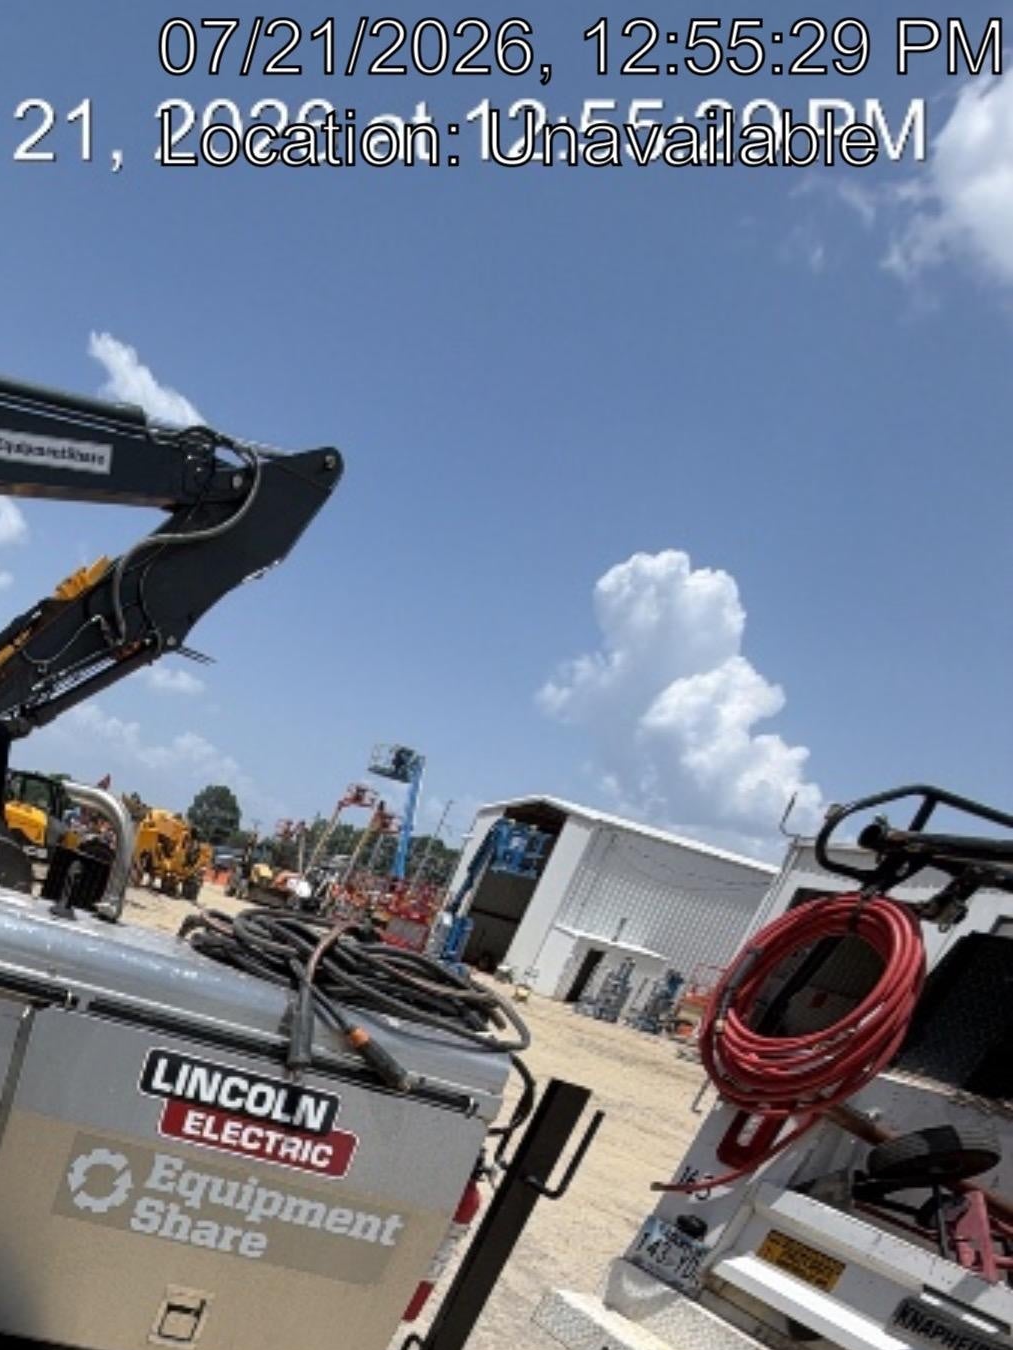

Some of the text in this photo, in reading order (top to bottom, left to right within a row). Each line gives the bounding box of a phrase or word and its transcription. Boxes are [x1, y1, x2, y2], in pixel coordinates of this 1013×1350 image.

[151, 1057, 330, 1131] LINCOLN
[181, 1111, 334, 1169] ELECTRIC
[129, 1195, 268, 1258] Share
[144, 1151, 404, 1247] Equipment
